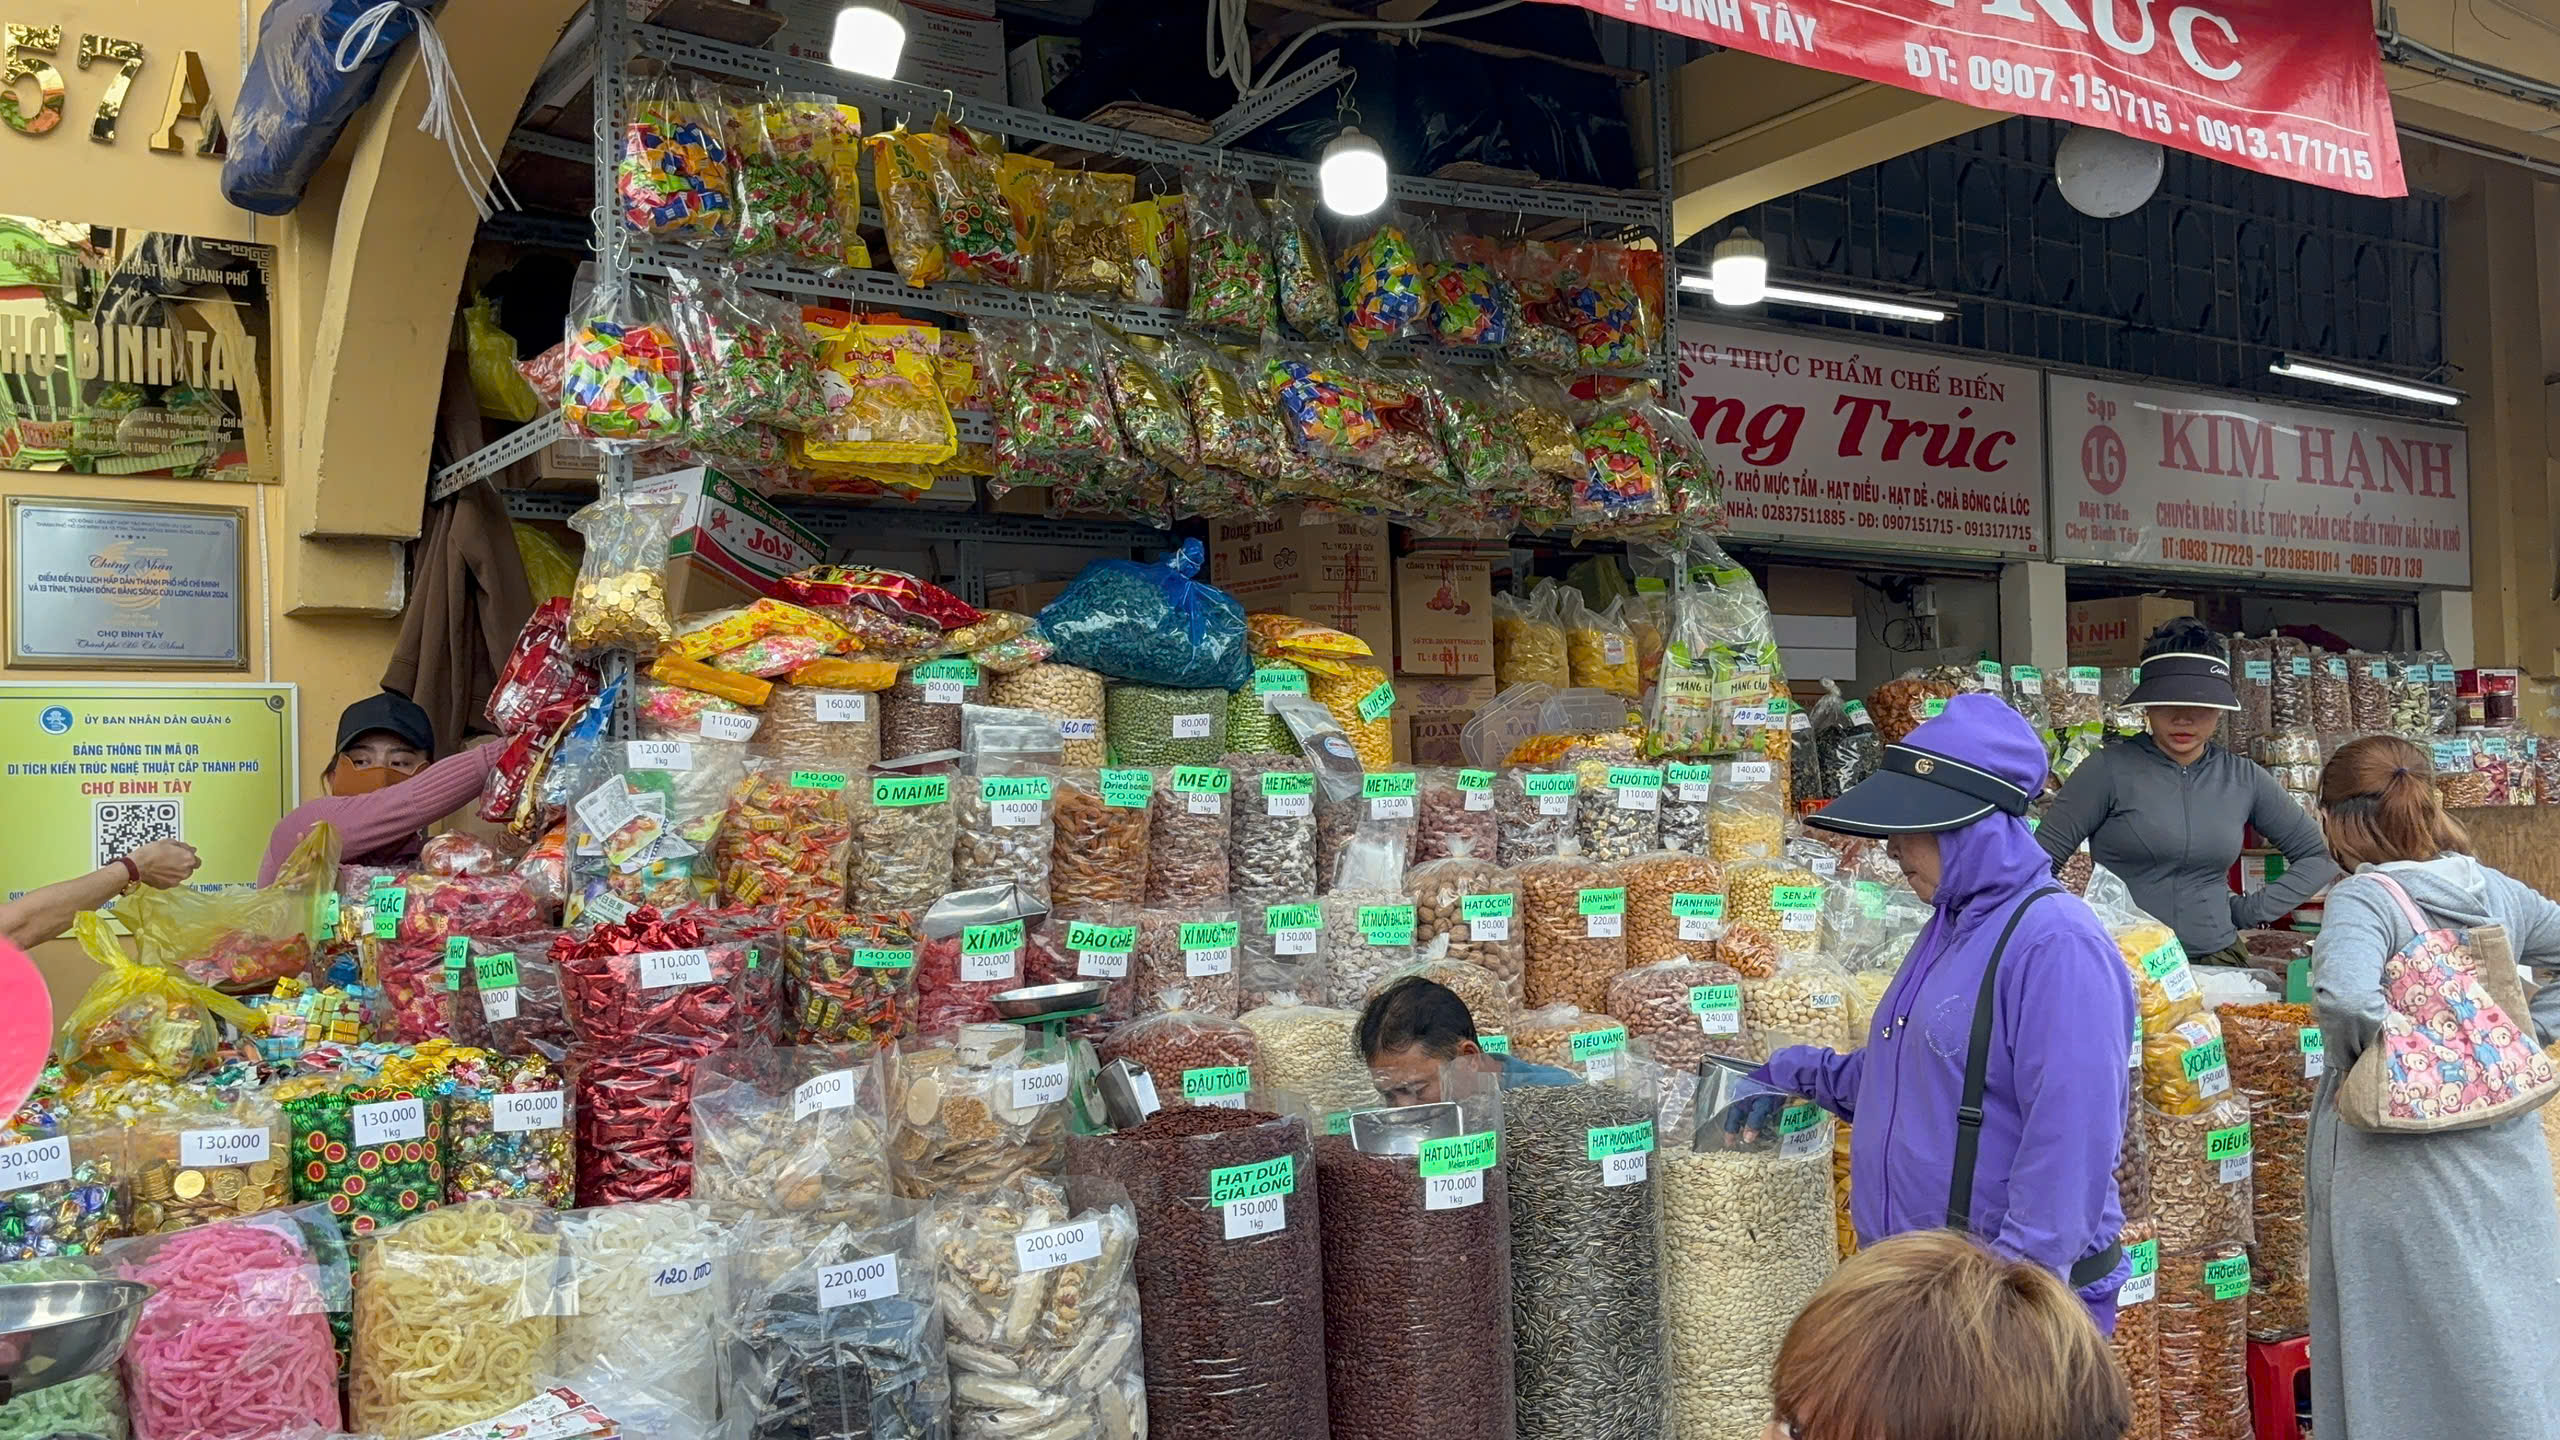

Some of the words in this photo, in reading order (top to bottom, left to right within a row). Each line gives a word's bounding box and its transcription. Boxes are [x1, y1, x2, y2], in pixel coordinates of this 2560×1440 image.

[1751, 1, 1817, 53] TÂY
[0, 22, 228, 157] 57A
[1904, 41, 1958, 86] ĐT:
[1968, 56, 2172, 135] 0907.151715
[2198, 114, 2375, 180] 0913.171715
[185, 265, 224, 284] THÀNH
[225, 268, 250, 287] PHỐ
[1726, 346, 1800, 376] THỰC
[1808, 353, 1882, 387] PHẨM
[1891, 365, 1941, 395] CHẾ
[1949, 374, 2005, 403] BIẾN
[2087, 392, 2117, 422] Sạp
[1833, 394, 2016, 472] Trúc
[2088, 434, 2119, 482] 16
[2158, 411, 2281, 482] KIM
[2296, 424, 2457, 507] HẠNH
[1735, 470, 1761, 493] KHÔ
[1764, 476, 1790, 501] MỰC
[1827, 480, 1850, 505] HẠT
[1889, 486, 1912, 510] HẠT
[1937, 484, 1959, 510] CHÀ
[2010, 492, 2031, 517] LÓC
[1761, 504, 1846, 526] 02837511885
[1882, 514, 1954, 535] 0907151715
[1964, 521, 2033, 541] 0913171715
[2156, 498, 2200, 530] CHUYÊN
[2203, 501, 2225, 532] BÁN
[2240, 510, 2251, 534] &
[2268, 509, 2298, 543] THỰC
[2300, 504, 2330, 541] PHẨM
[2331, 511, 2352, 543] CHẾ
[2353, 512, 2376, 545] BIẾN
[2210, 541, 2254, 567] 777229
[2264, 545, 2340, 573] 02838591014
[2404, 557, 2424, 579] 139
[928, 681, 960, 692] 80.000
[826, 699, 861, 710] 160.000
[102, 715, 126, 725] BAN
[129, 713, 161, 725] NHÂN
[164, 713, 188, 725] DÂN
[190, 713, 222, 728] QUẬN
[225, 715, 232, 725] 6
[711, 715, 752, 730] 110.000
[1181, 717, 1208, 729] 80.000
[724, 730, 738, 739] 1kg
[72, 741, 103, 756] BẢNG
[106, 741, 142, 756] THÔNG
[144, 744, 162, 755] TIN
[165, 741, 183, 755] MÃ
[185, 744, 199, 756] QR
[638, 743, 681, 755] 120.000
[8, 764, 19, 775] DI
[22, 761, 47, 775] TÍCH
[50, 760, 76, 775] KIẾN
[80, 760, 107, 775] TRÚC
[110, 760, 140, 776] NGHỆ
[142, 760, 175, 776] THUẬT
[178, 759, 199, 773] CẤP
[203, 759, 236, 772] THÀNH
[239, 759, 260, 773] PHỐ
[654, 756, 668, 766] 1kg
[1736, 765, 1766, 774] 140.000
[794, 772, 845, 784] 140.000
[1178, 773, 1210, 788] ME
[81, 780, 115, 798] CHỢ
[119, 779, 158, 794] BÌNH
[163, 779, 192, 794] TÂY
[877, 784, 889, 801] Ô
[892, 786, 922, 800] MAI
[924, 782, 945, 798] ME
[985, 783, 996, 797] Ô
[998, 783, 1023, 797] MAI
[1625, 790, 1654, 799] 110.000
[1191, 793, 1219, 803] 80.000
[1274, 797, 1305, 807] 110.000
[1377, 798, 1408, 808] 130.000
[1001, 803, 1038, 814] 140.000
[1477, 920, 1505, 930] 150.000
[967, 928, 987, 951] XÍ
[1071, 929, 1107, 947] ĐÀO
[1281, 932, 1312, 942] 150.000
[651, 954, 701, 971] 110.000
[971, 954, 1010, 967] 120.000
[1087, 954, 1123, 966] 110.000
[1195, 950, 1227, 962] 120.000
[669, 970, 688, 982] 1kg
[1705, 1012, 1734, 1023] 240.000
[1021, 1073, 1063, 1091] 150.000
[799, 1078, 842, 1103] 200.000
[1036, 1091, 1050, 1103] 1kg
[506, 1096, 559, 1113] 160.000
[808, 1099, 824, 1112] 1kg
[361, 1106, 417, 1127] 130.000
[525, 1115, 543, 1127] 1kg
[383, 1126, 402, 1140] 1kg
[197, 1133, 261, 1152] 130.000
[218, 1152, 239, 1166] 1kg
[1613, 1155, 1644, 1172] 80.000
[16, 1168, 40, 1183] 1kg
[1214, 1187, 1246, 1201] GIA
[1250, 1174, 1292, 1196] LONG
[1433, 1175, 1477, 1192] 170.000
[1232, 1198, 1279, 1217] 150.000
[1449, 1195, 1463, 1205] 1kg
[1249, 1219, 1264, 1230] 1kg
[1026, 1228, 1085, 1253] 200.000
[1048, 1250, 1069, 1265] 1kg
[823, 1263, 886, 1289] 220.000
[846, 1284, 868, 1301] 1kg
